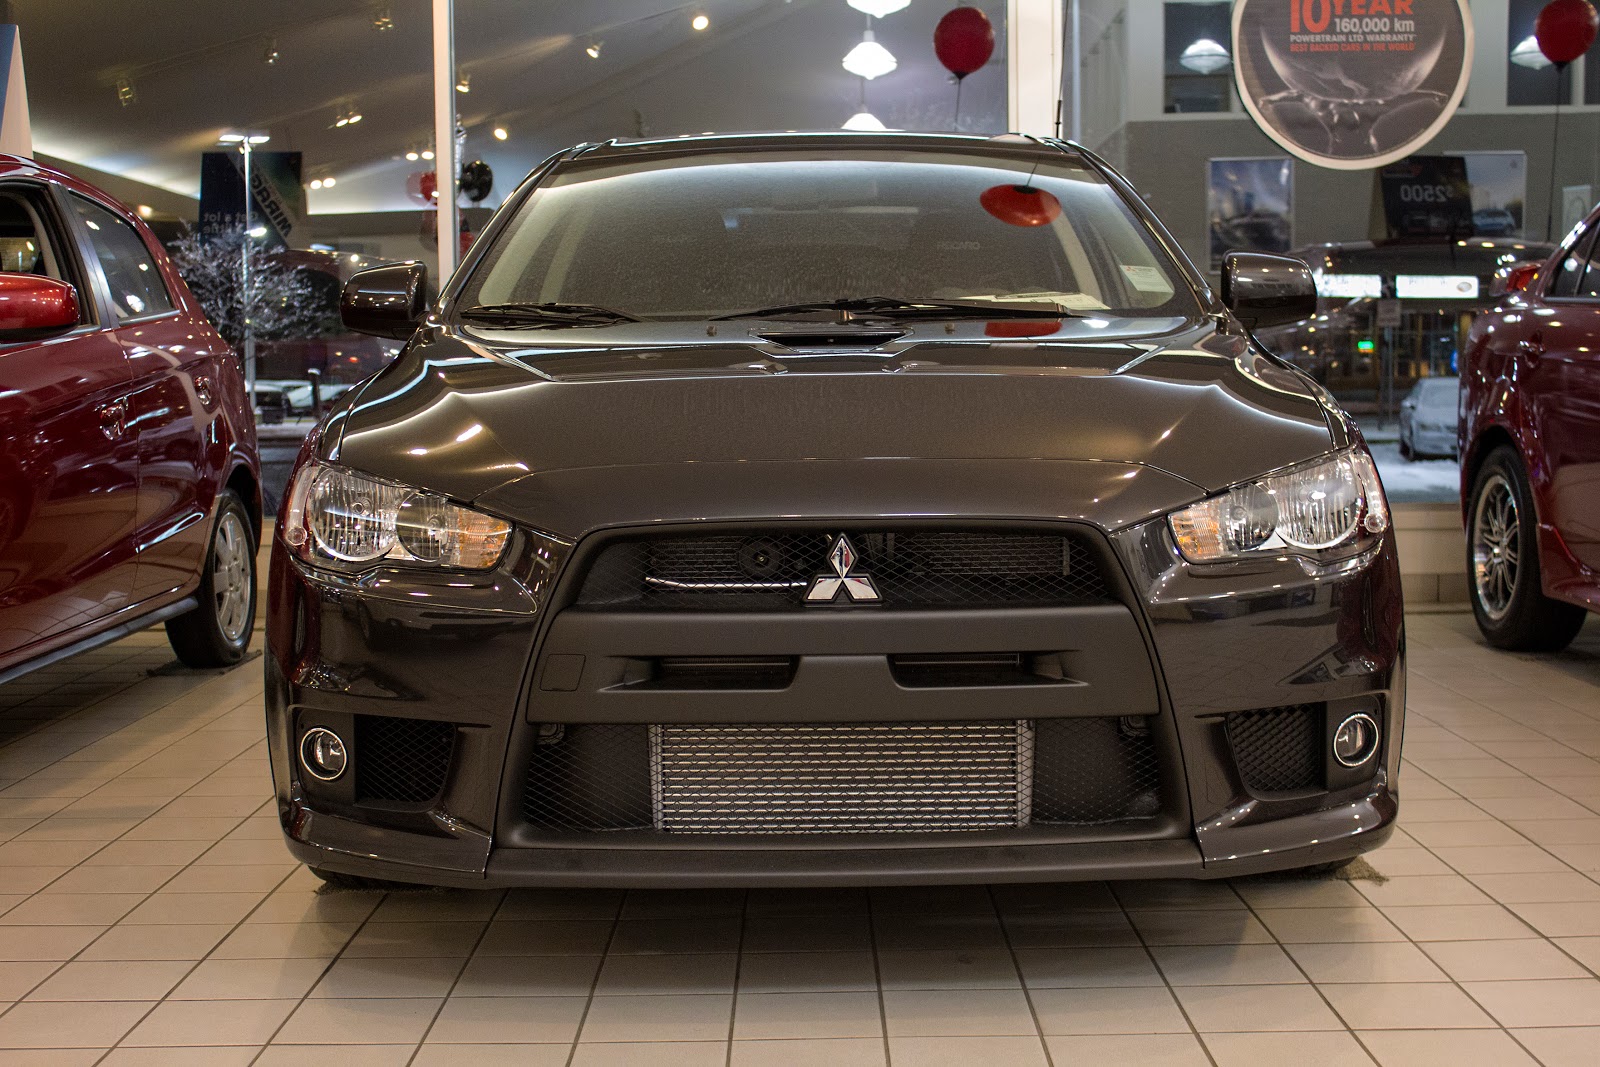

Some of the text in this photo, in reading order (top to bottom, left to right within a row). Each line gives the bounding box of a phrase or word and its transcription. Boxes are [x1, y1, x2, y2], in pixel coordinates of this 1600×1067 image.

[1290, 0, 1414, 33] 10 YEAR
[1334, 18, 1415, 34] 160,000 km
[1290, 34, 1346, 42] POWERTRAIN
[1348, 34, 1364, 42] LTD
[1290, 42, 1415, 52] BEST BACKED CARS IN THE WORLD
